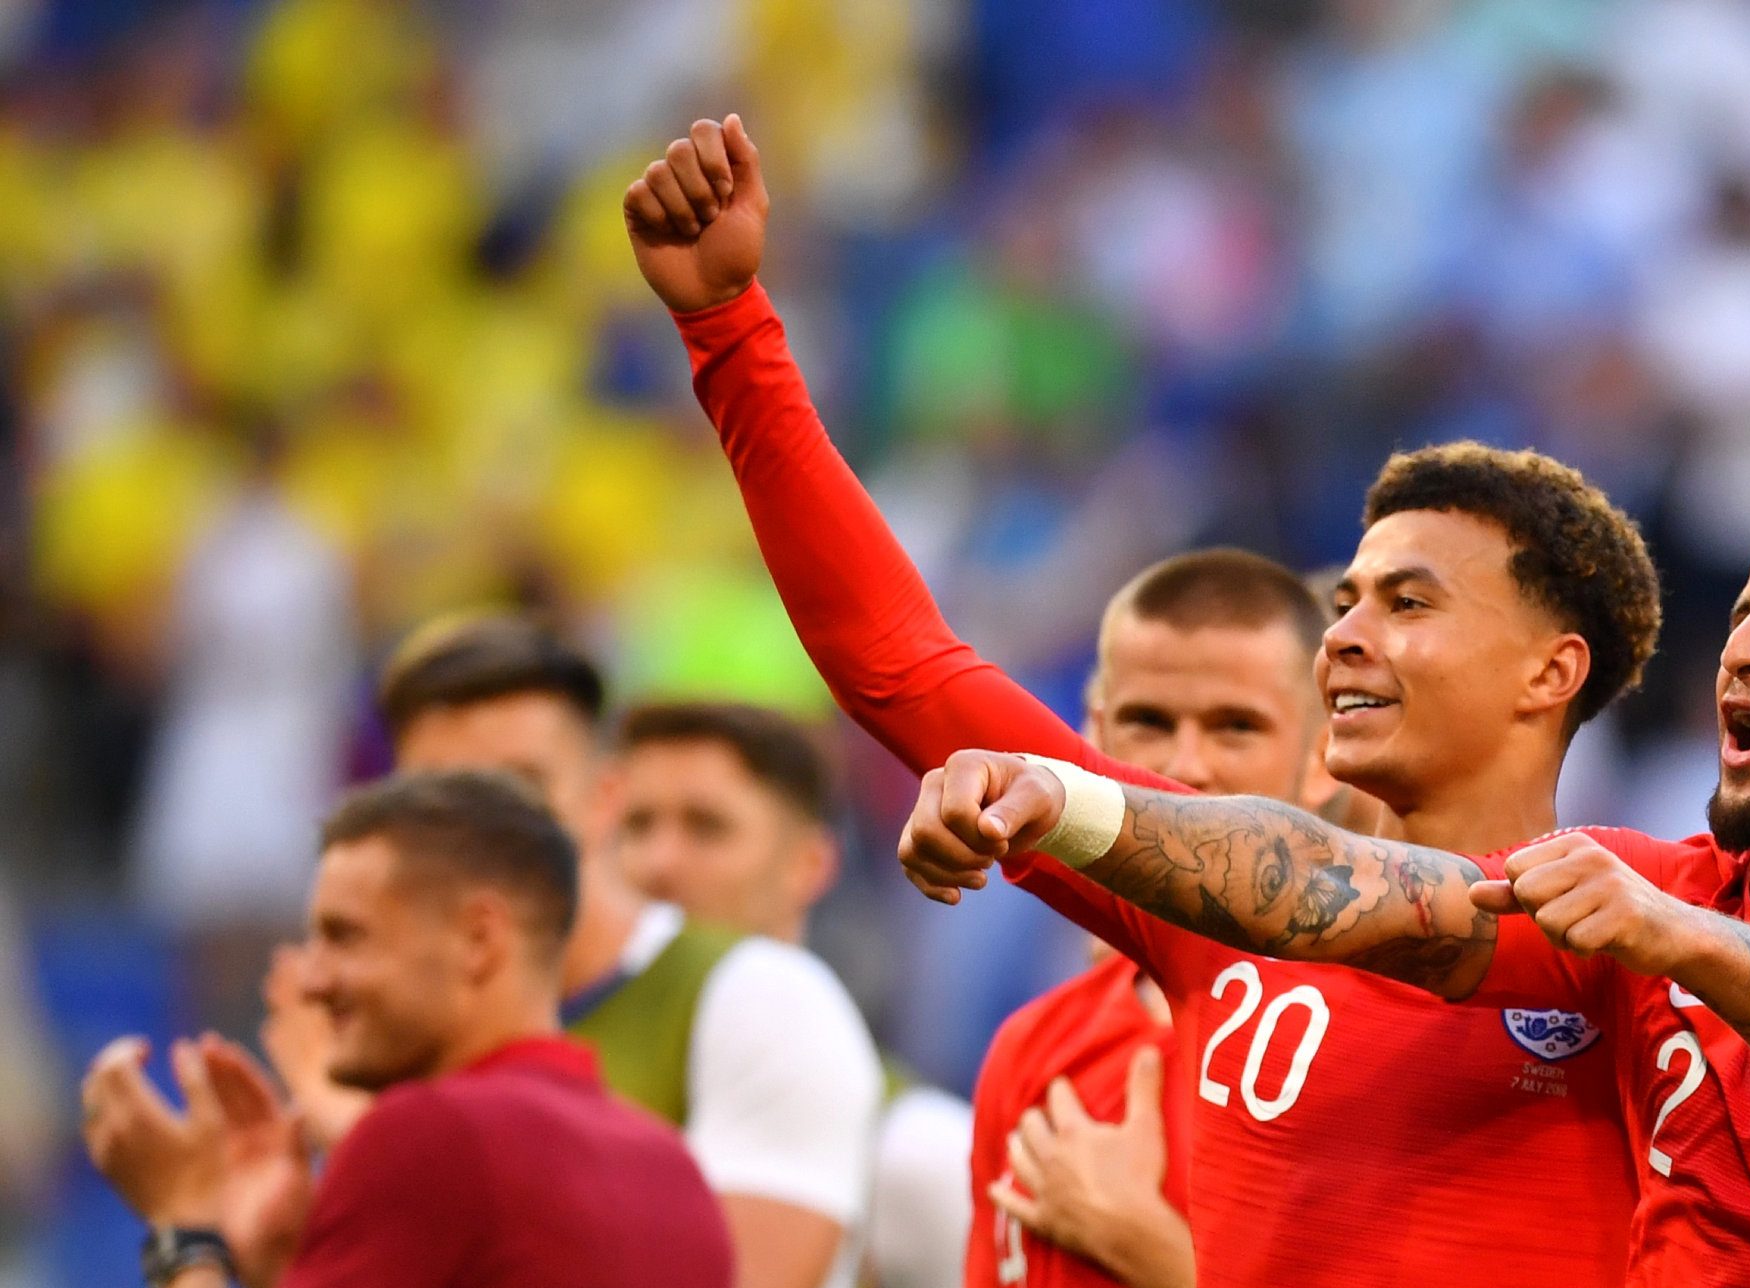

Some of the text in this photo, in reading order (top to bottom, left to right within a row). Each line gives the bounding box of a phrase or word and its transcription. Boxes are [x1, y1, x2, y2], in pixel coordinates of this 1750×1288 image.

[1199, 960, 1331, 1122] 20
[1510, 1076, 1520, 1089] 7
[1648, 1030, 1707, 1179] 2
